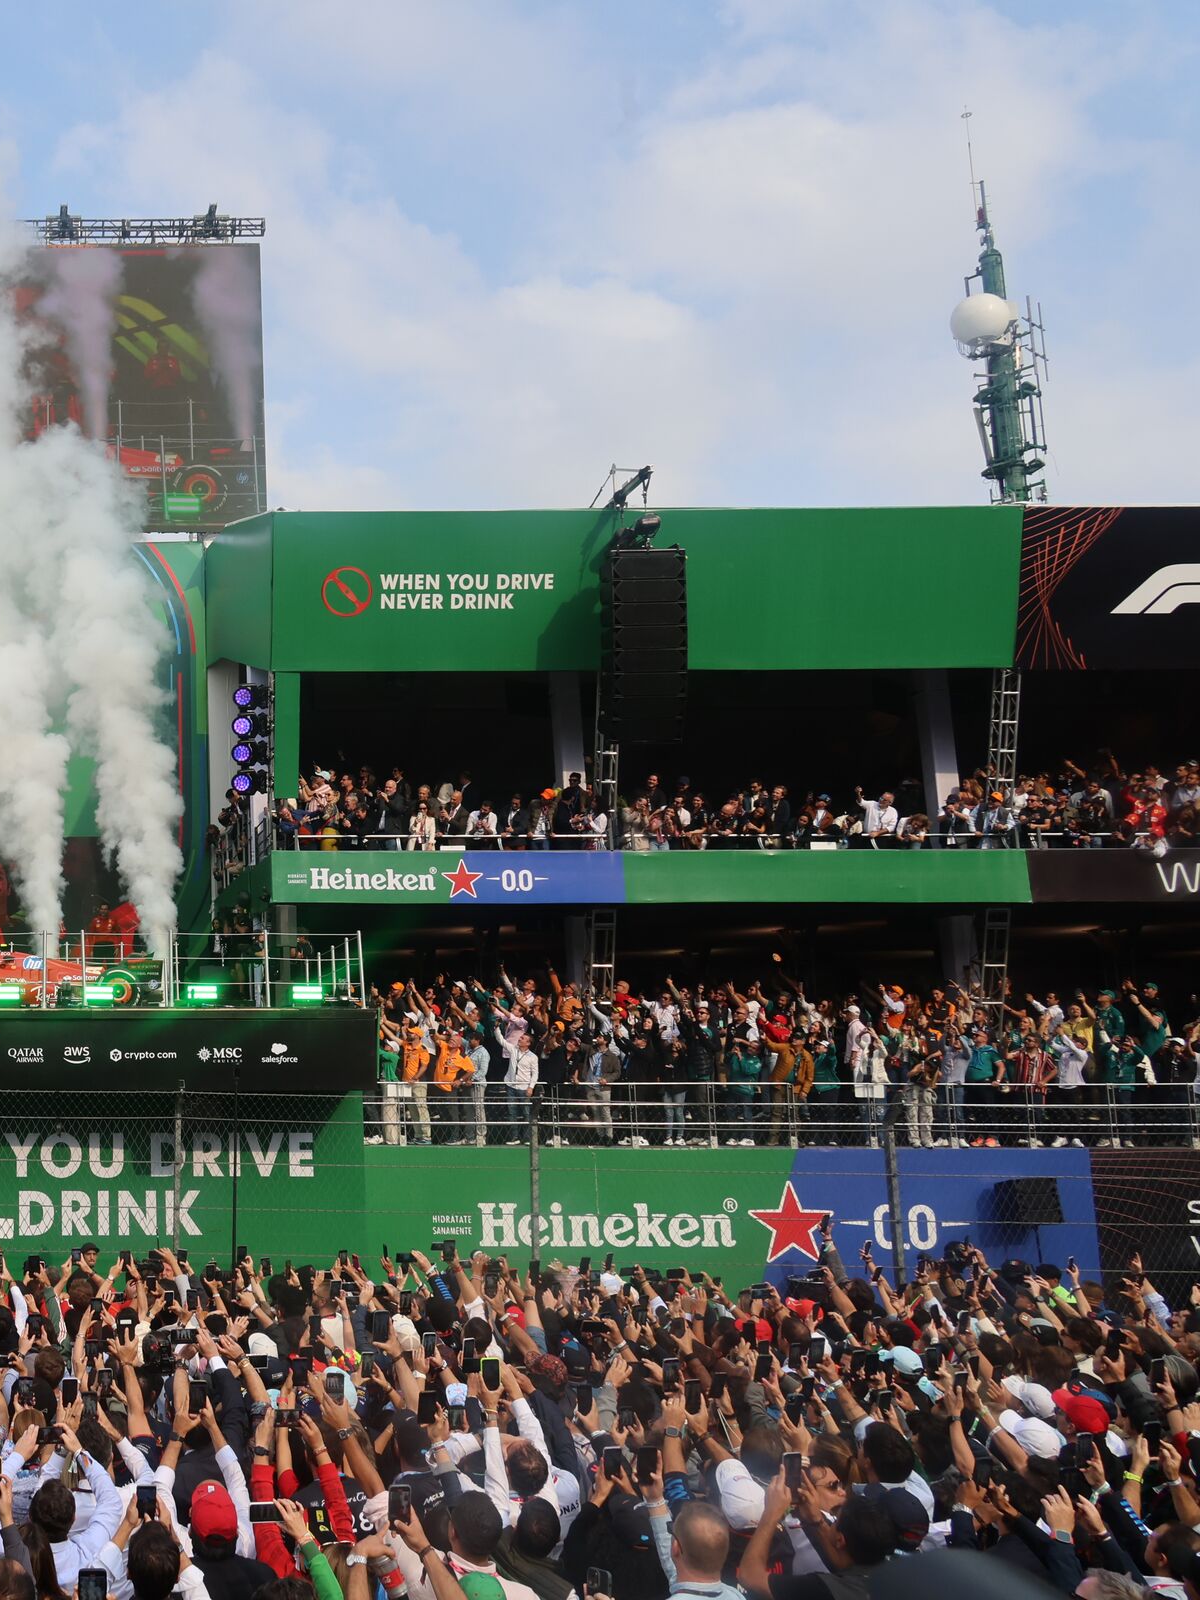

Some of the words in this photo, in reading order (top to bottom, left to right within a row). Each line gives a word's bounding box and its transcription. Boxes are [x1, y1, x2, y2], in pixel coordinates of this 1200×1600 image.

[380, 574, 441, 590] WHEN
[446, 574, 489, 590] YOU
[496, 573, 555, 590] DRIVE
[380, 593, 443, 610] NEVER
[450, 593, 514, 610] DRINK
[7, 1047, 43, 1058] QATAR
[64, 1046, 90, 1057] aws
[213, 1047, 242, 1058] MSC
[261, 1055, 298, 1065] salesforce
[3, 1132, 124, 1178] YOU
[150, 1132, 315, 1177] DRIVE
[18, 1190, 203, 1236] DRINK
[432, 1227, 472, 1236] SANAMENTE
